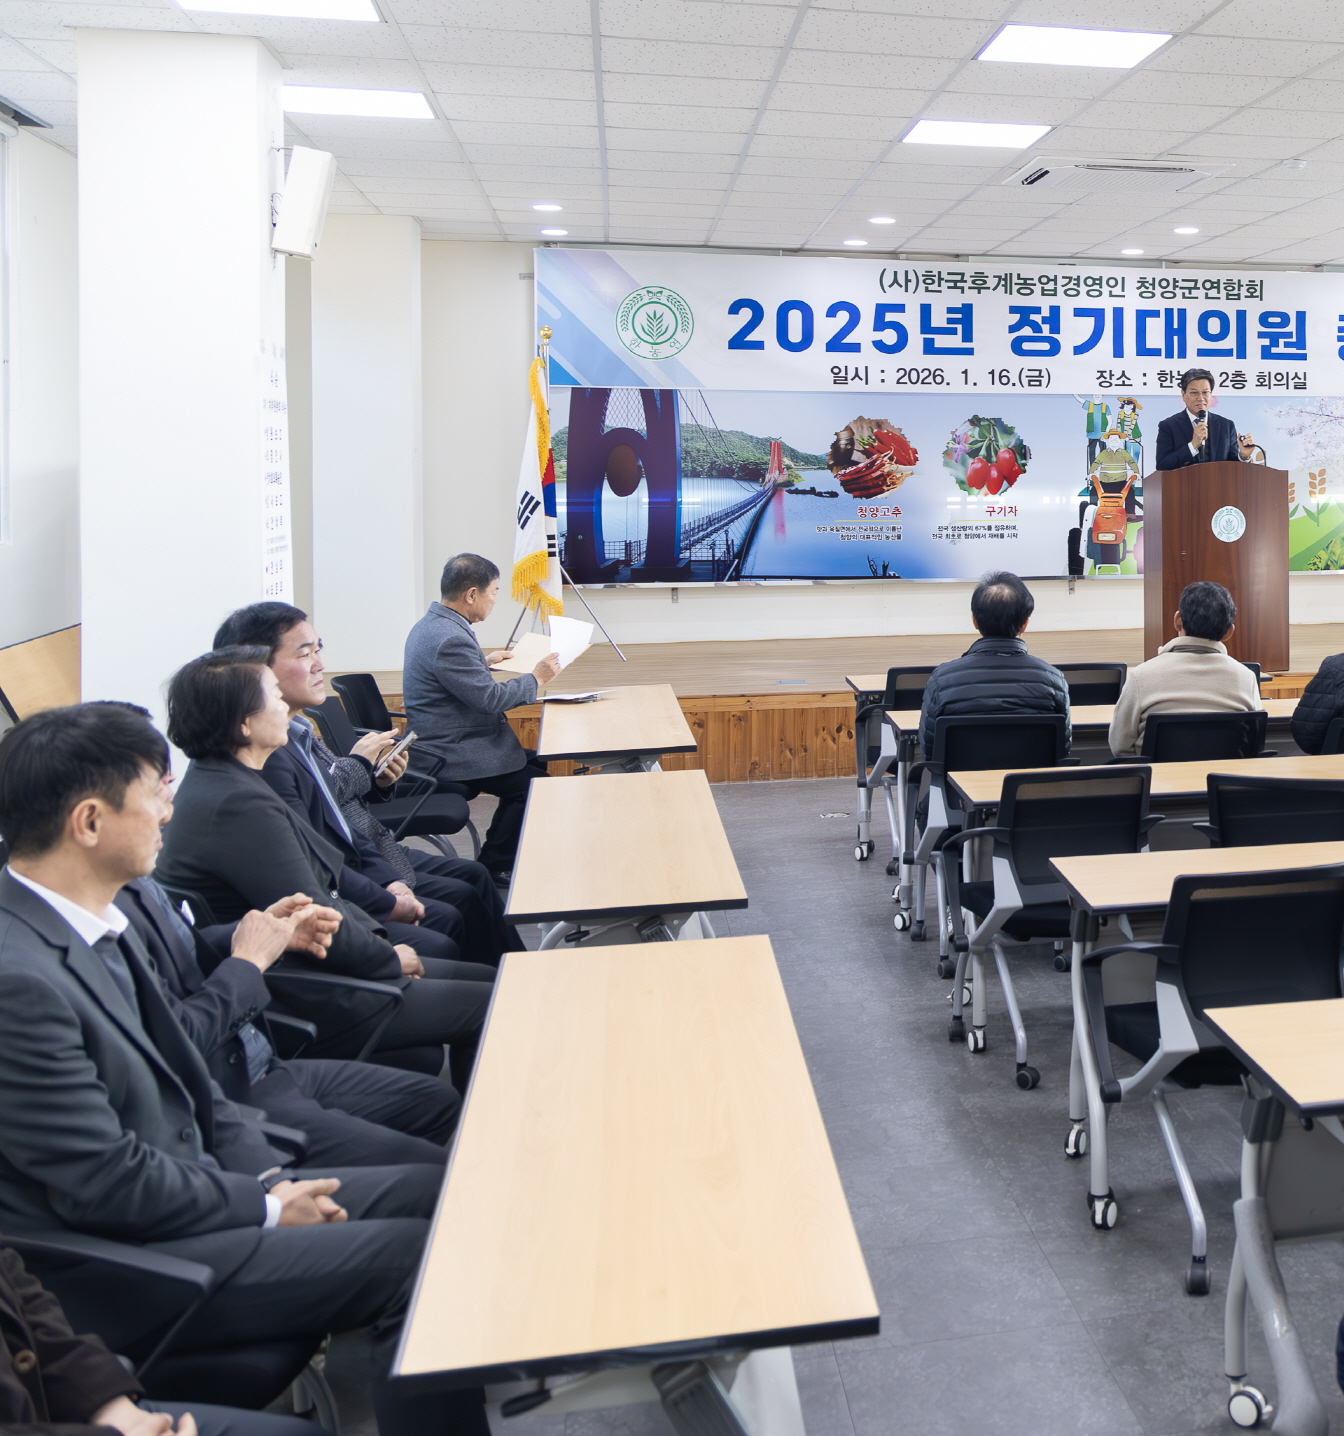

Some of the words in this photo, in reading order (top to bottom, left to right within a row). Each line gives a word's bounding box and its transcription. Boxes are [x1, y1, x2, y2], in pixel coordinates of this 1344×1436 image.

[879, 268, 1126, 298] (사)한국후계농업경영인
[1136, 276, 1265, 302] 청양군연합회
[727, 298, 975, 356] 2025년
[1008, 304, 1308, 361] 정기대의원
[830, 365, 869, 386] 일시
[896, 367, 950, 386] 2026.
[961, 368, 978, 387] 1.
[988, 367, 1051, 388] 16.(금)
[1096, 369, 1133, 389] 장소
[1218, 370, 1248, 390] 2층
[1255, 371, 1308, 390] 회의실
[857, 506, 903, 518] 청양고추
[985, 506, 1018, 517] 구기자
